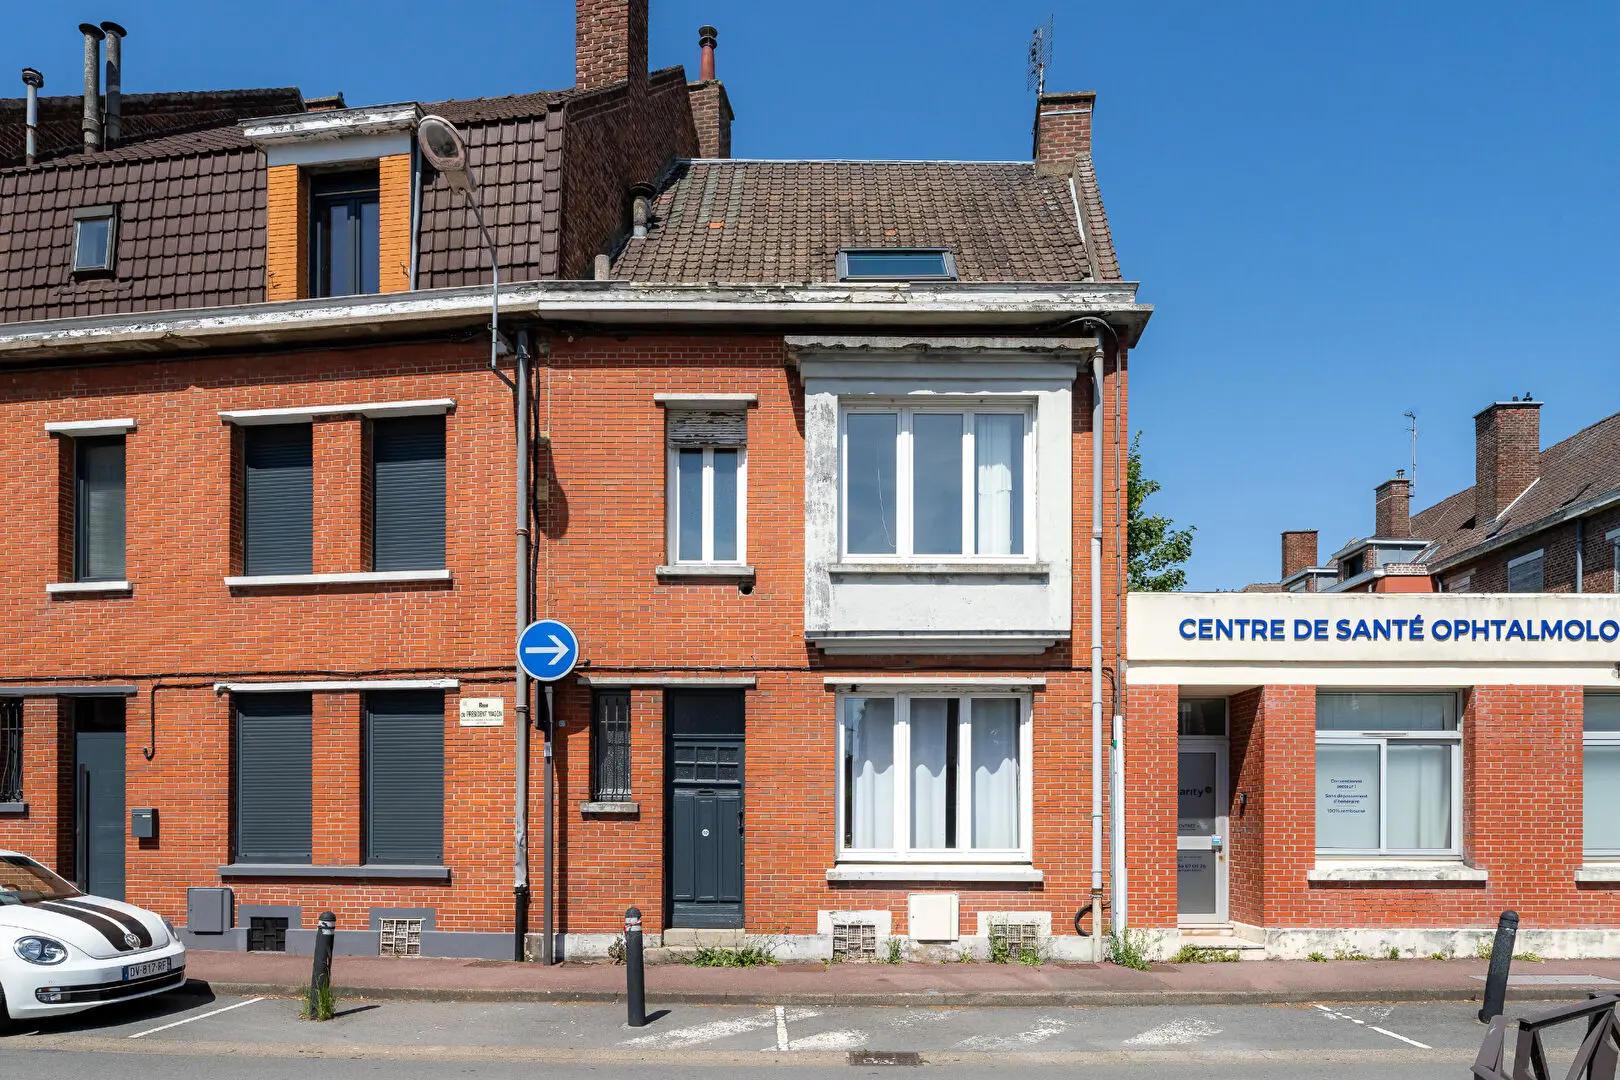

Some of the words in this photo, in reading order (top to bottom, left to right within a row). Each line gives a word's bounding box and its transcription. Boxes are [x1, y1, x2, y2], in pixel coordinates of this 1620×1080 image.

[1179, 618, 1286, 641] CENTRE
[1294, 618, 1329, 641] DE
[1336, 614, 1425, 641] SANTÉ
[1431, 618, 1620, 642] OPHTALMOLO
